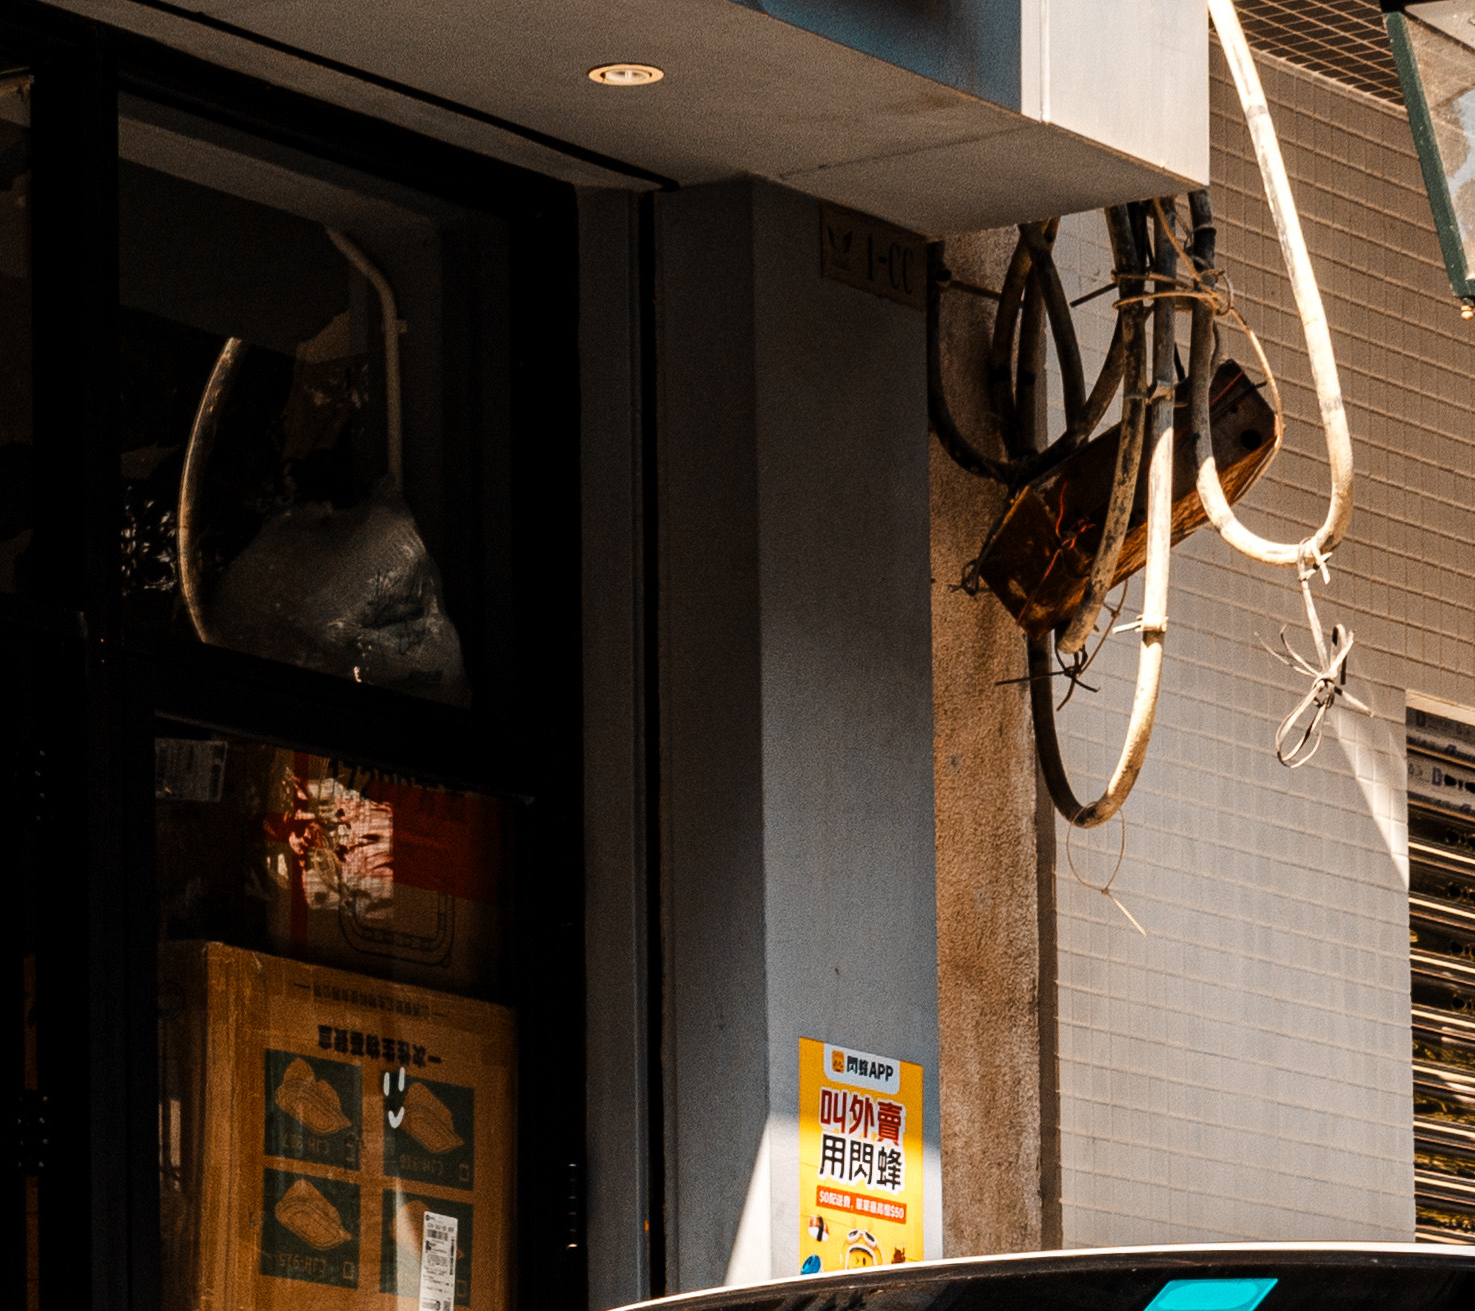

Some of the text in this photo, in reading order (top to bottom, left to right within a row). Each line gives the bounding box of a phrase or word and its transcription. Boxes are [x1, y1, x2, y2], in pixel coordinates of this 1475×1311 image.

[847, 1055, 894, 1082] 閃蜂APP
[820, 1089, 903, 1146] 叫外賣
[819, 1134, 903, 1191] 用閃蜂
